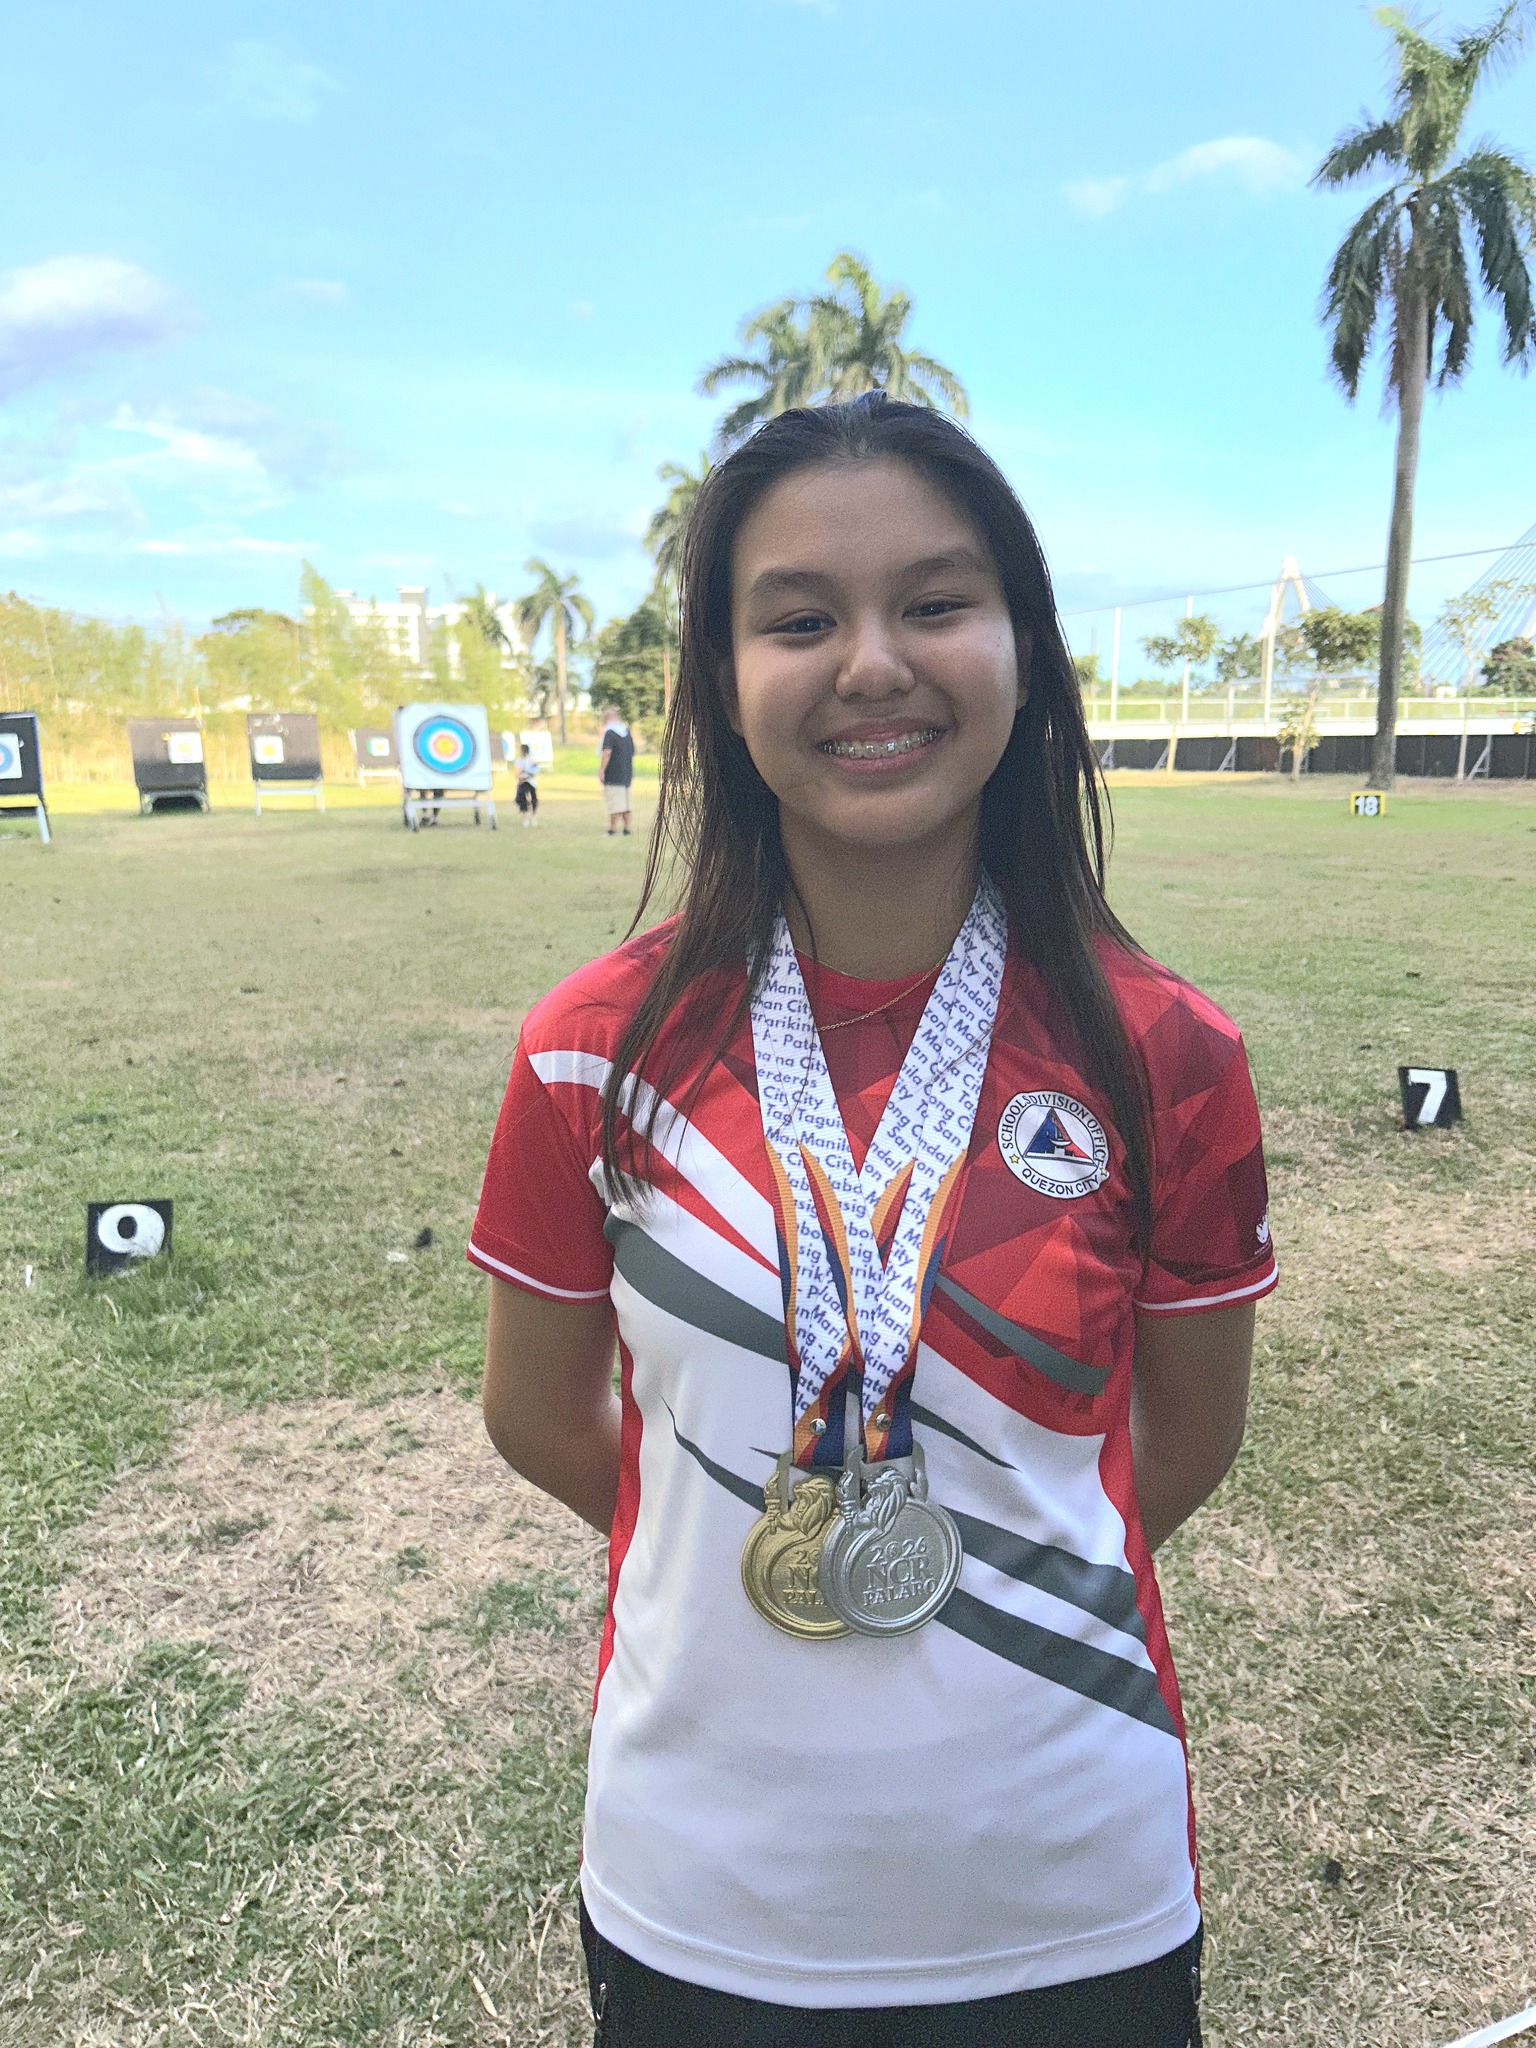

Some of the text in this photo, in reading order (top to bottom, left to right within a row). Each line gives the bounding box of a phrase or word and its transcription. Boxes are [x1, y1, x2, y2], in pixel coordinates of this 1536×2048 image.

[1355, 796, 1379, 817] 18
[791, 1090, 824, 1110] City
[1408, 1068, 1447, 1125] 7
[933, 1120, 962, 1147] San
[1001, 1094, 1033, 1150] SCHOOLS
[1027, 1093, 1089, 1120] DIVISION
[886, 1126, 913, 1155] San
[1021, 1167, 1100, 1196] QUEZON CITY
[865, 1555, 929, 1590] NCR
[862, 1577, 937, 1606] PALARO
